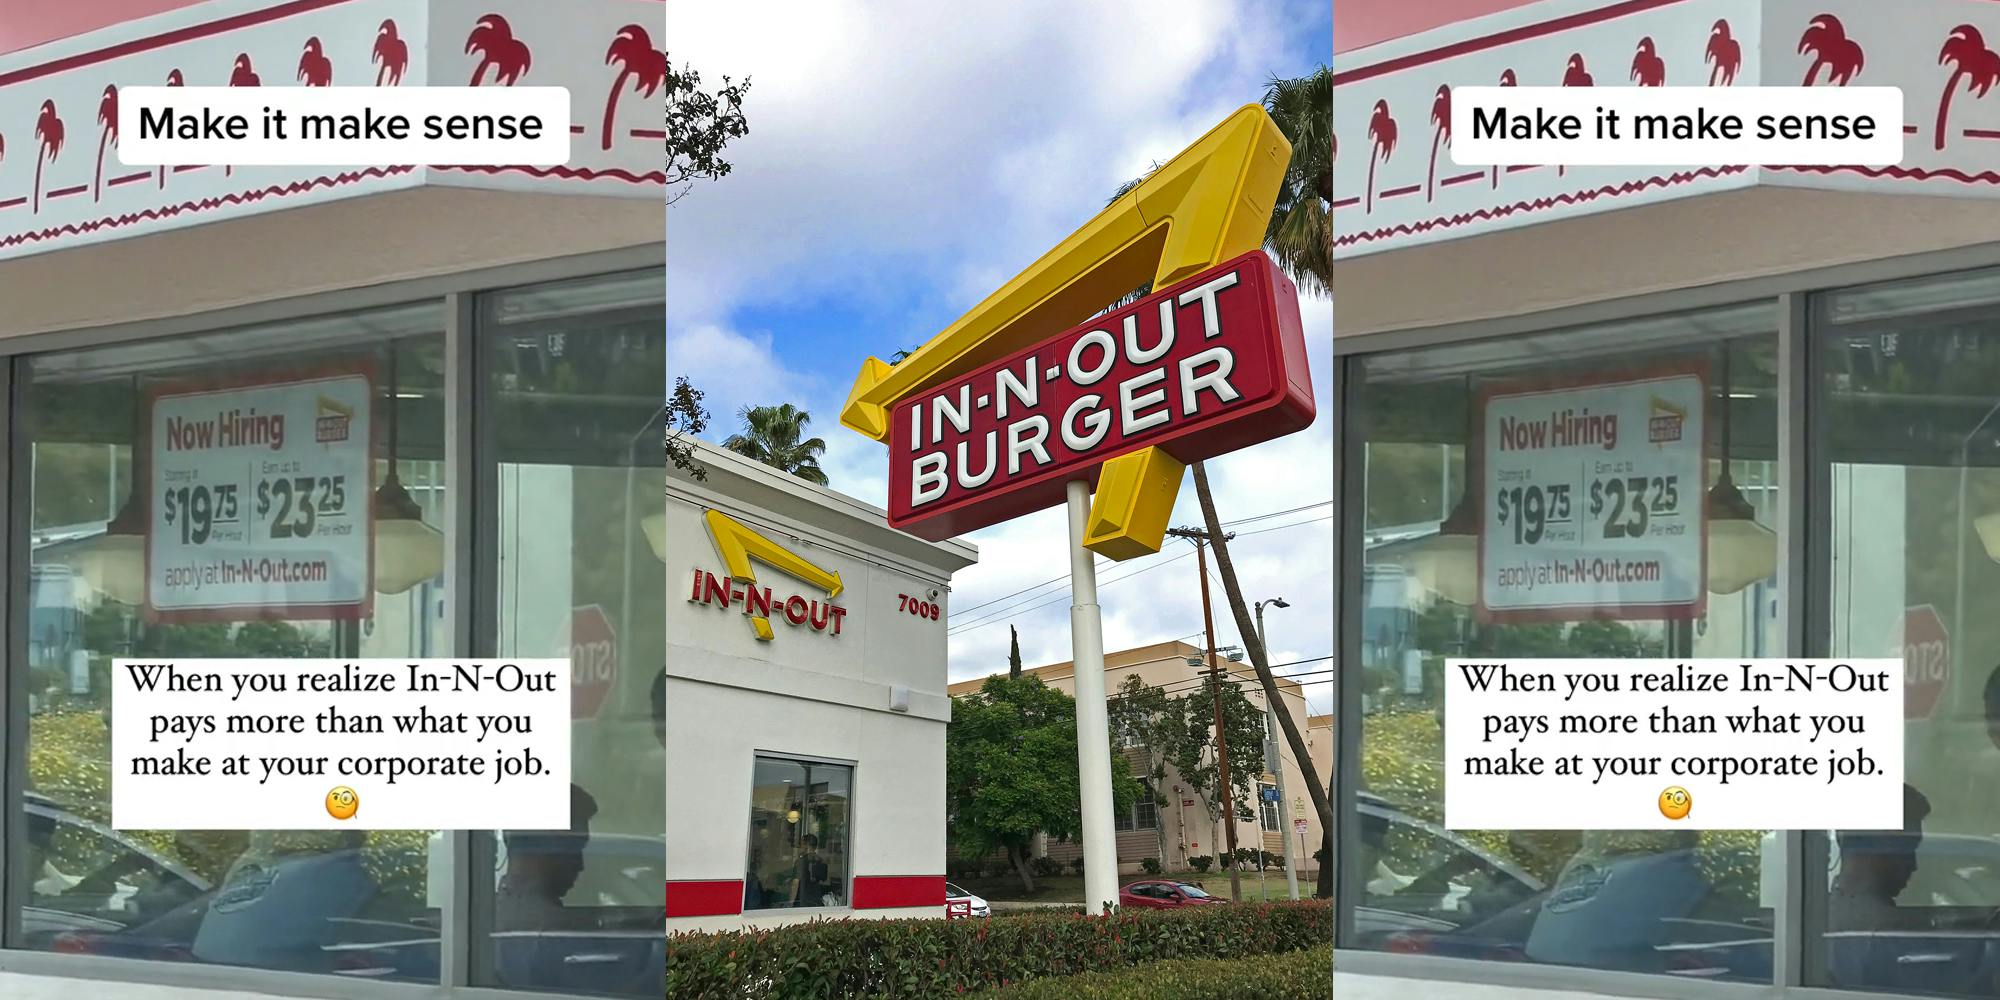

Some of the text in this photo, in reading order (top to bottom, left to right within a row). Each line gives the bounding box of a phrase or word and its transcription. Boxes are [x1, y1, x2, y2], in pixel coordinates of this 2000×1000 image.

[911, 271, 1239, 451] IN-N-OUT
[166, 416, 214, 451] Now
[219, 408, 285, 450] Hiring
[911, 346, 1240, 508] BURGER
[1499, 416, 1547, 451] Now
[1552, 408, 1618, 450] Hiring
[165, 558, 327, 590] apply at In-N-Out.com
[1498, 558, 1660, 590] apply at In-N-Out.com
[689, 569, 847, 635] IN-N-OUT
[898, 593, 940, 621] 7009
